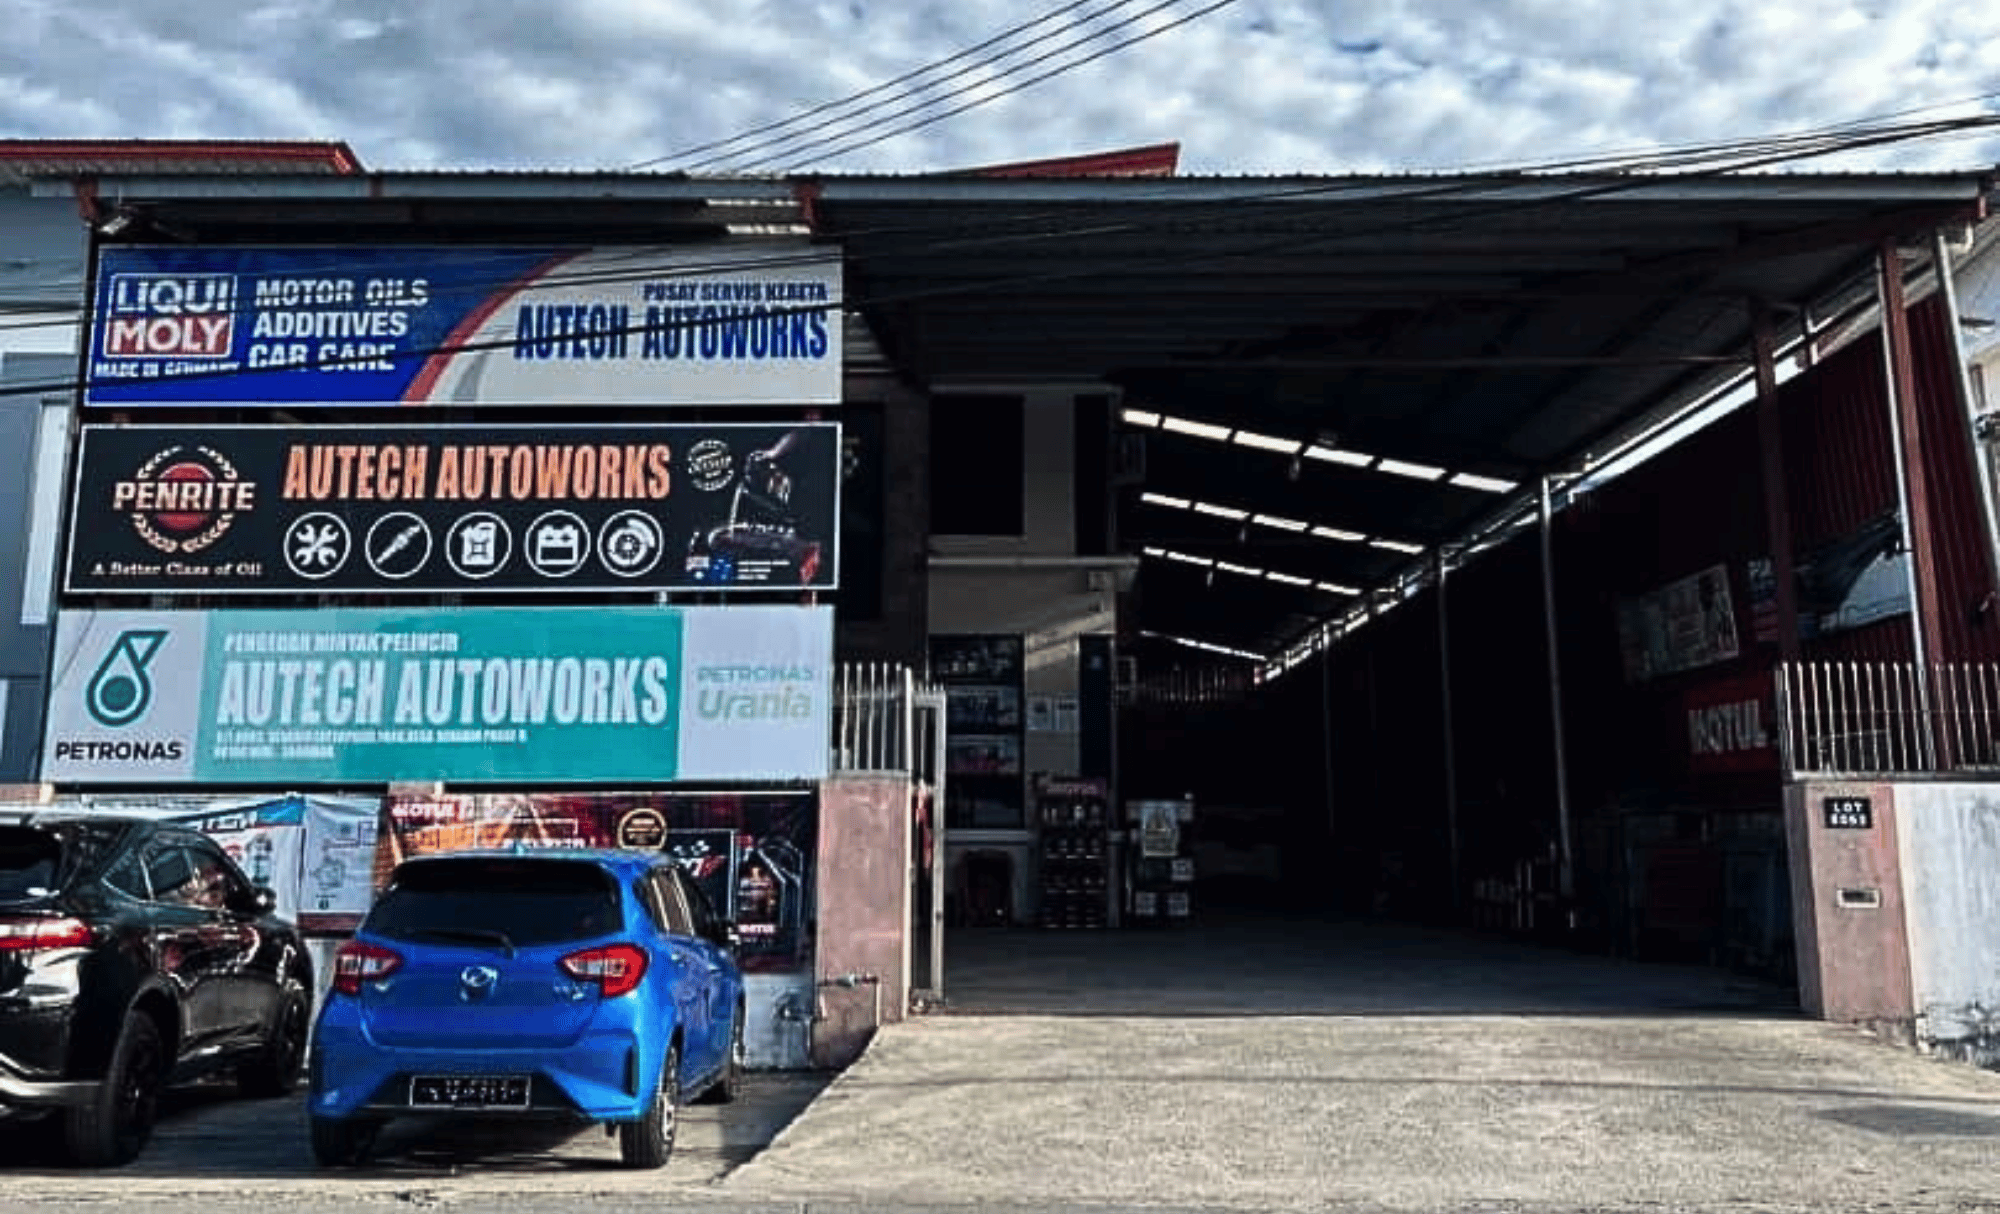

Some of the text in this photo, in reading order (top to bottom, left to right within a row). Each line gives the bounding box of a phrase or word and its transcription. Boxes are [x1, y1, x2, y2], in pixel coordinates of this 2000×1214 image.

[116, 279, 228, 312] LIQUI
[255, 279, 429, 307] MOTOR OILS
[109, 317, 231, 353] MOLY
[253, 311, 408, 338] ADDITIVES
[513, 302, 829, 360] AUTECH AUTOWORKS
[94, 361, 139, 378] MADE
[142, 361, 160, 378] IN
[248, 342, 397, 371] CAR CARE
[282, 444, 429, 500] AUTECH
[435, 443, 670, 500] AUTOWORKS
[112, 481, 257, 511] PENRITE
[91, 561, 263, 576] A Better Class of Oil
[697, 665, 813, 683] PETRONAS
[215, 655, 669, 725] AUTECH AUTOWORKS
[698, 685, 812, 721] Urania
[1686, 698, 1769, 756] MOTUL
[55, 740, 182, 761] PETRONAS
[1833, 801, 1863, 812] LOT
